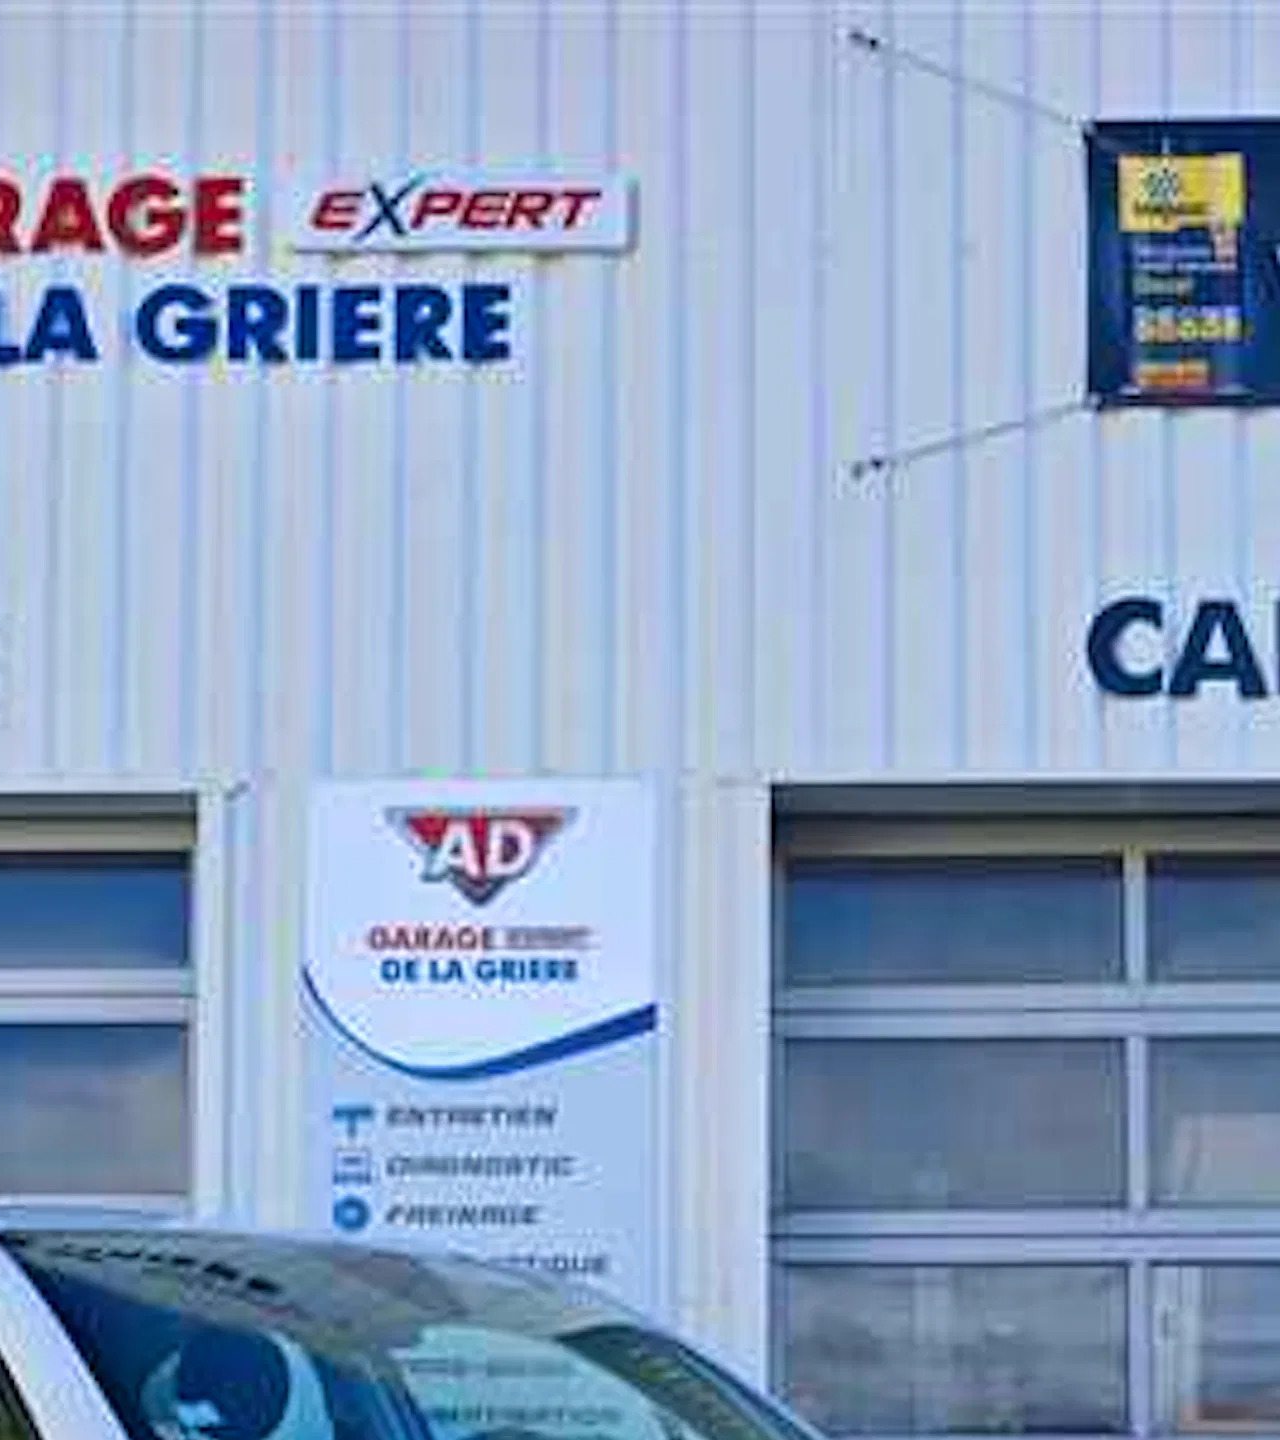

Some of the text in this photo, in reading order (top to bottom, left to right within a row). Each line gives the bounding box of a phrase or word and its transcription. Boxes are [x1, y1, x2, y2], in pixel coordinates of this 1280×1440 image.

[306, 174, 604, 244] EXPERT
[135, 284, 513, 364] GRIERE
[422, 819, 533, 881] AD
[369, 925, 491, 952] GARAGE
[380, 958, 418, 983] DE
[428, 958, 466, 983] LA
[385, 1105, 558, 1129] ENTRETIEN
